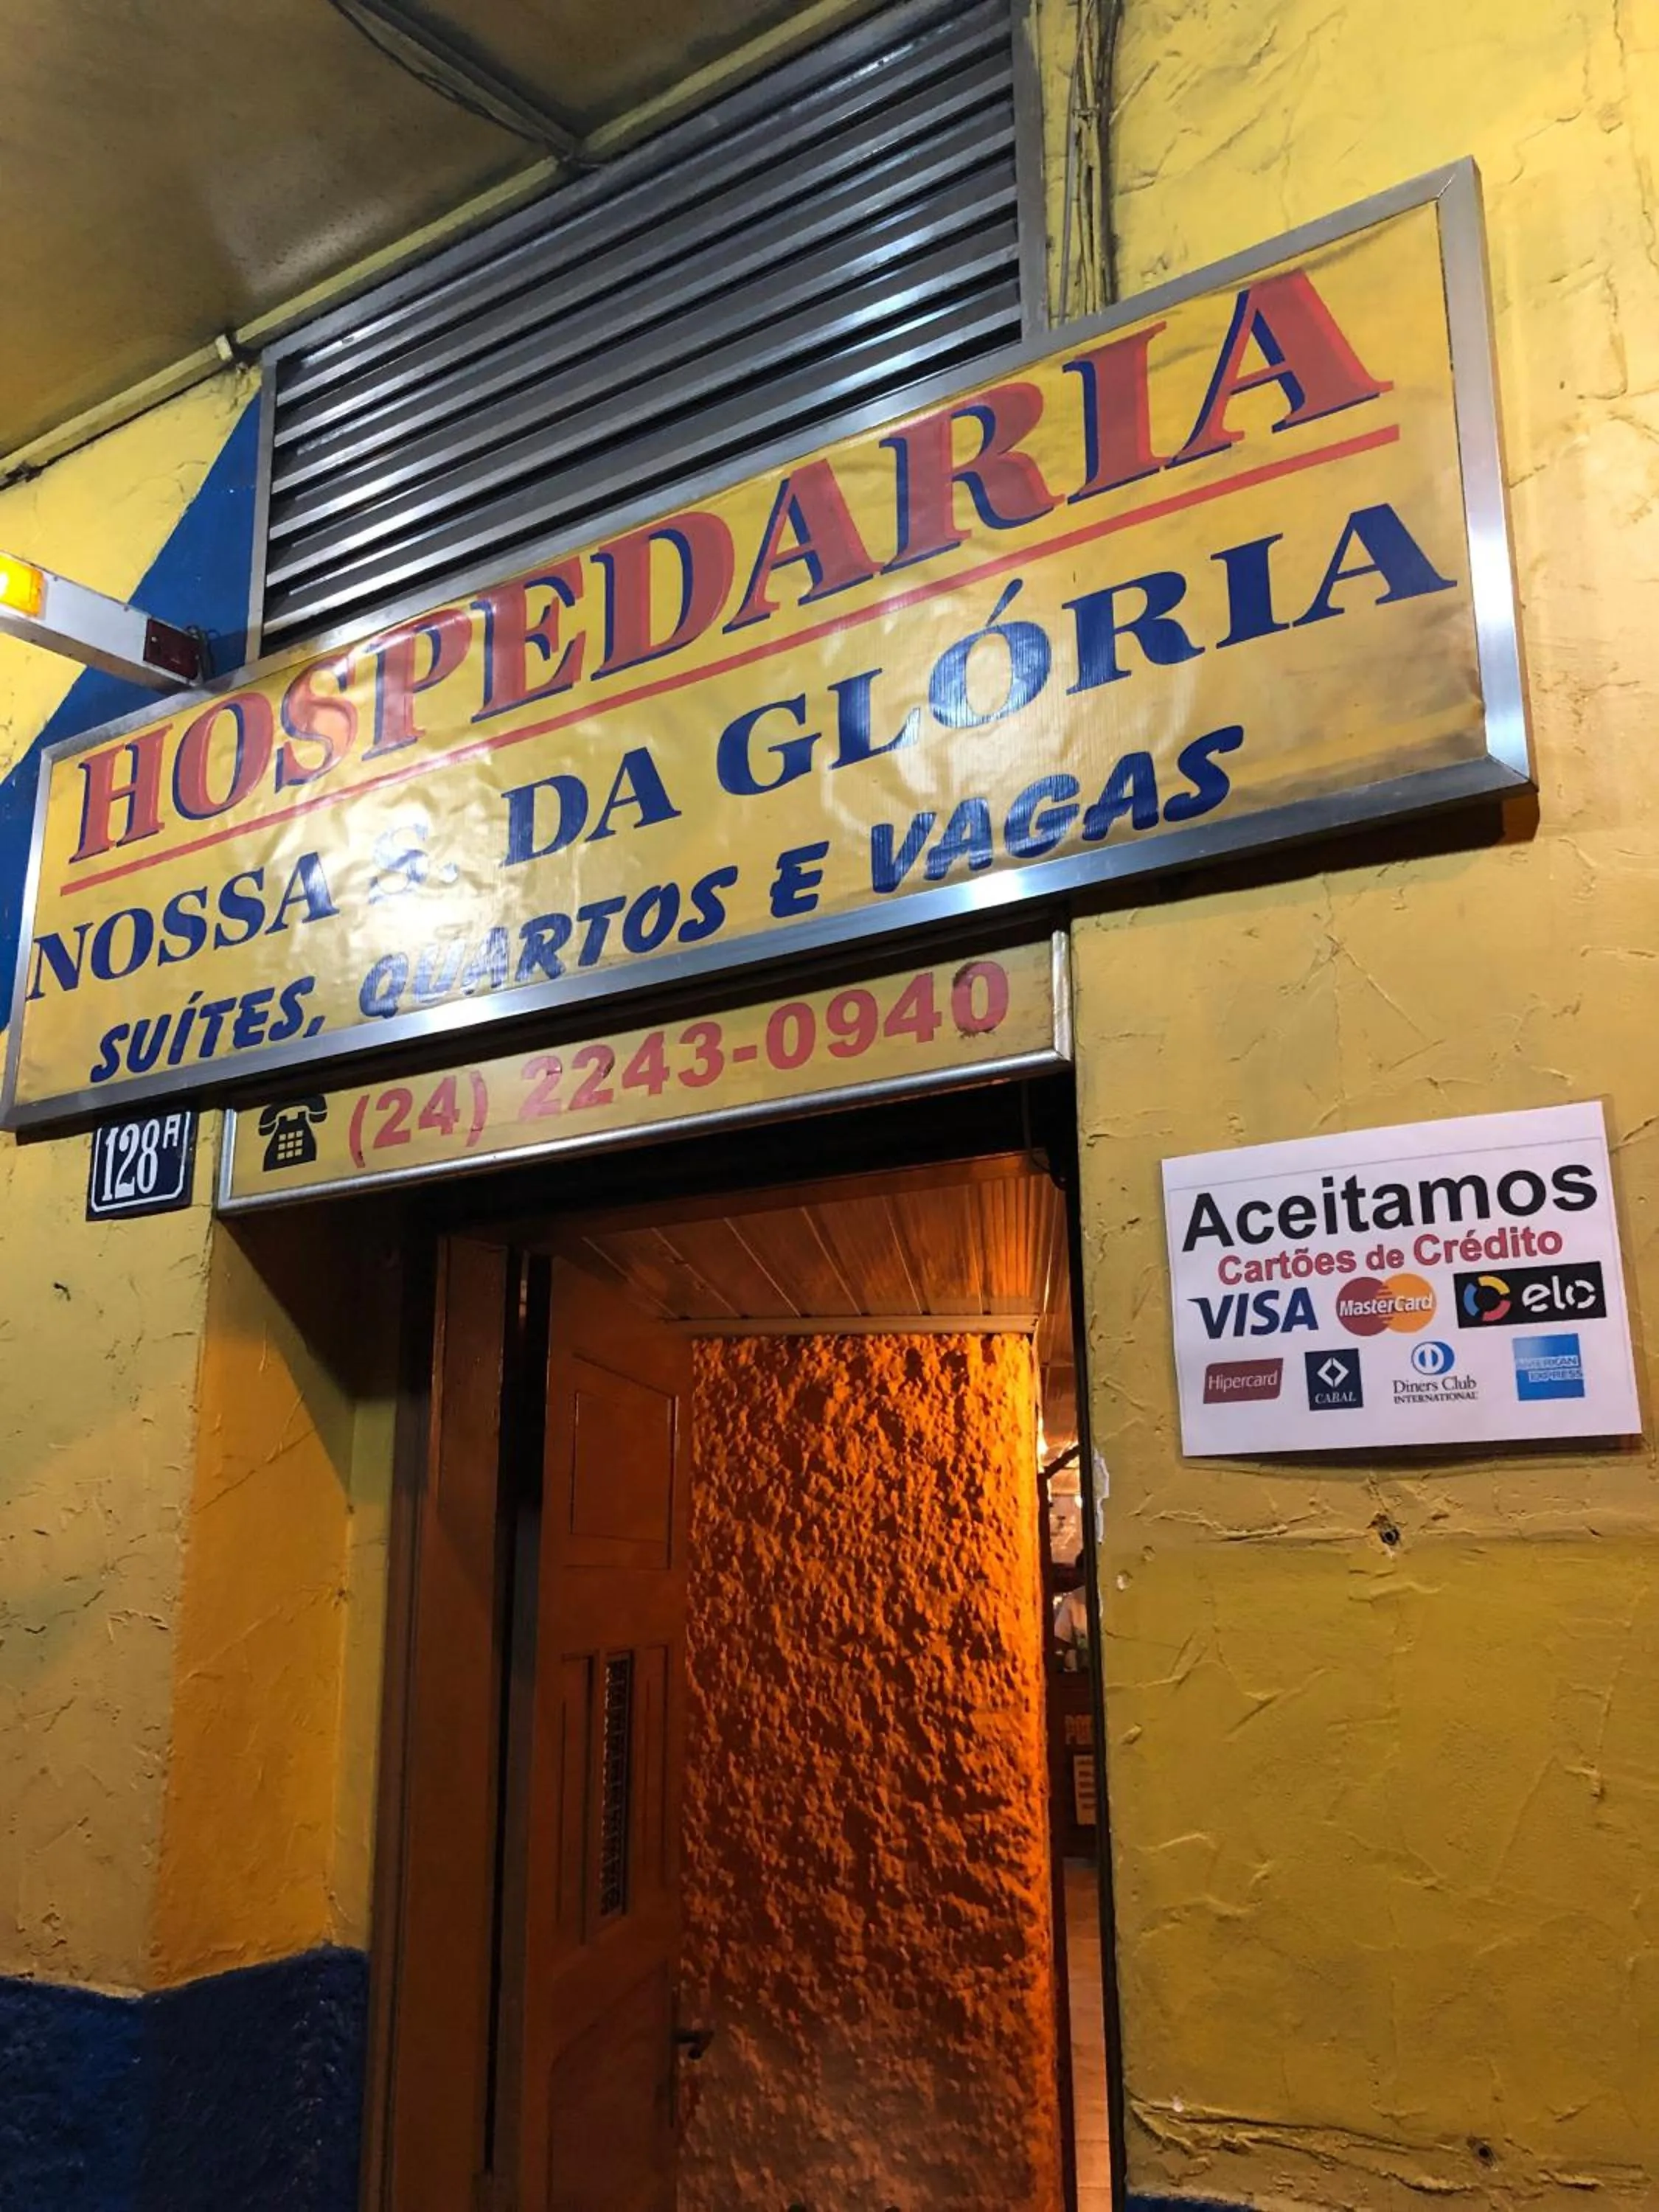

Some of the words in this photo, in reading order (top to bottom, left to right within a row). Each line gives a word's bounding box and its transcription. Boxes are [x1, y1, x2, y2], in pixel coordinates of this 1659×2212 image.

[69, 268, 1394, 863] HOSPEDARIA
[27, 852, 340, 999] NOSSA
[499, 746, 681, 868] DA
[717, 503, 1457, 796] GLÓRIA
[91, 976, 325, 1083] SUÍTES,
[359, 866, 737, 1018] QUARTOS
[770, 841, 829, 918] E
[870, 726, 1244, 894] VAGAS
[349, 1071, 488, 1169] (24)
[518, 961, 1009, 1123] 2243-0940
[1182, 1164, 1598, 1252] Aceitamos
[1218, 1248, 1357, 1285] Cartões
[1366, 1245, 1405, 1270] de
[1413, 1227, 1563, 1266] Crédito
[1187, 1287, 1319, 1339] VISA
[1338, 1292, 1433, 1317] MasterCard
[1521, 1275, 1596, 1312] elo
[1208, 1370, 1278, 1392] Hipercard
[1315, 1391, 1357, 1404] CABAL
[1392, 1380, 1439, 1394] Diners
[1441, 1375, 1477, 1390] Club
[1394, 1391, 1478, 1404] INTERNATIONAL
